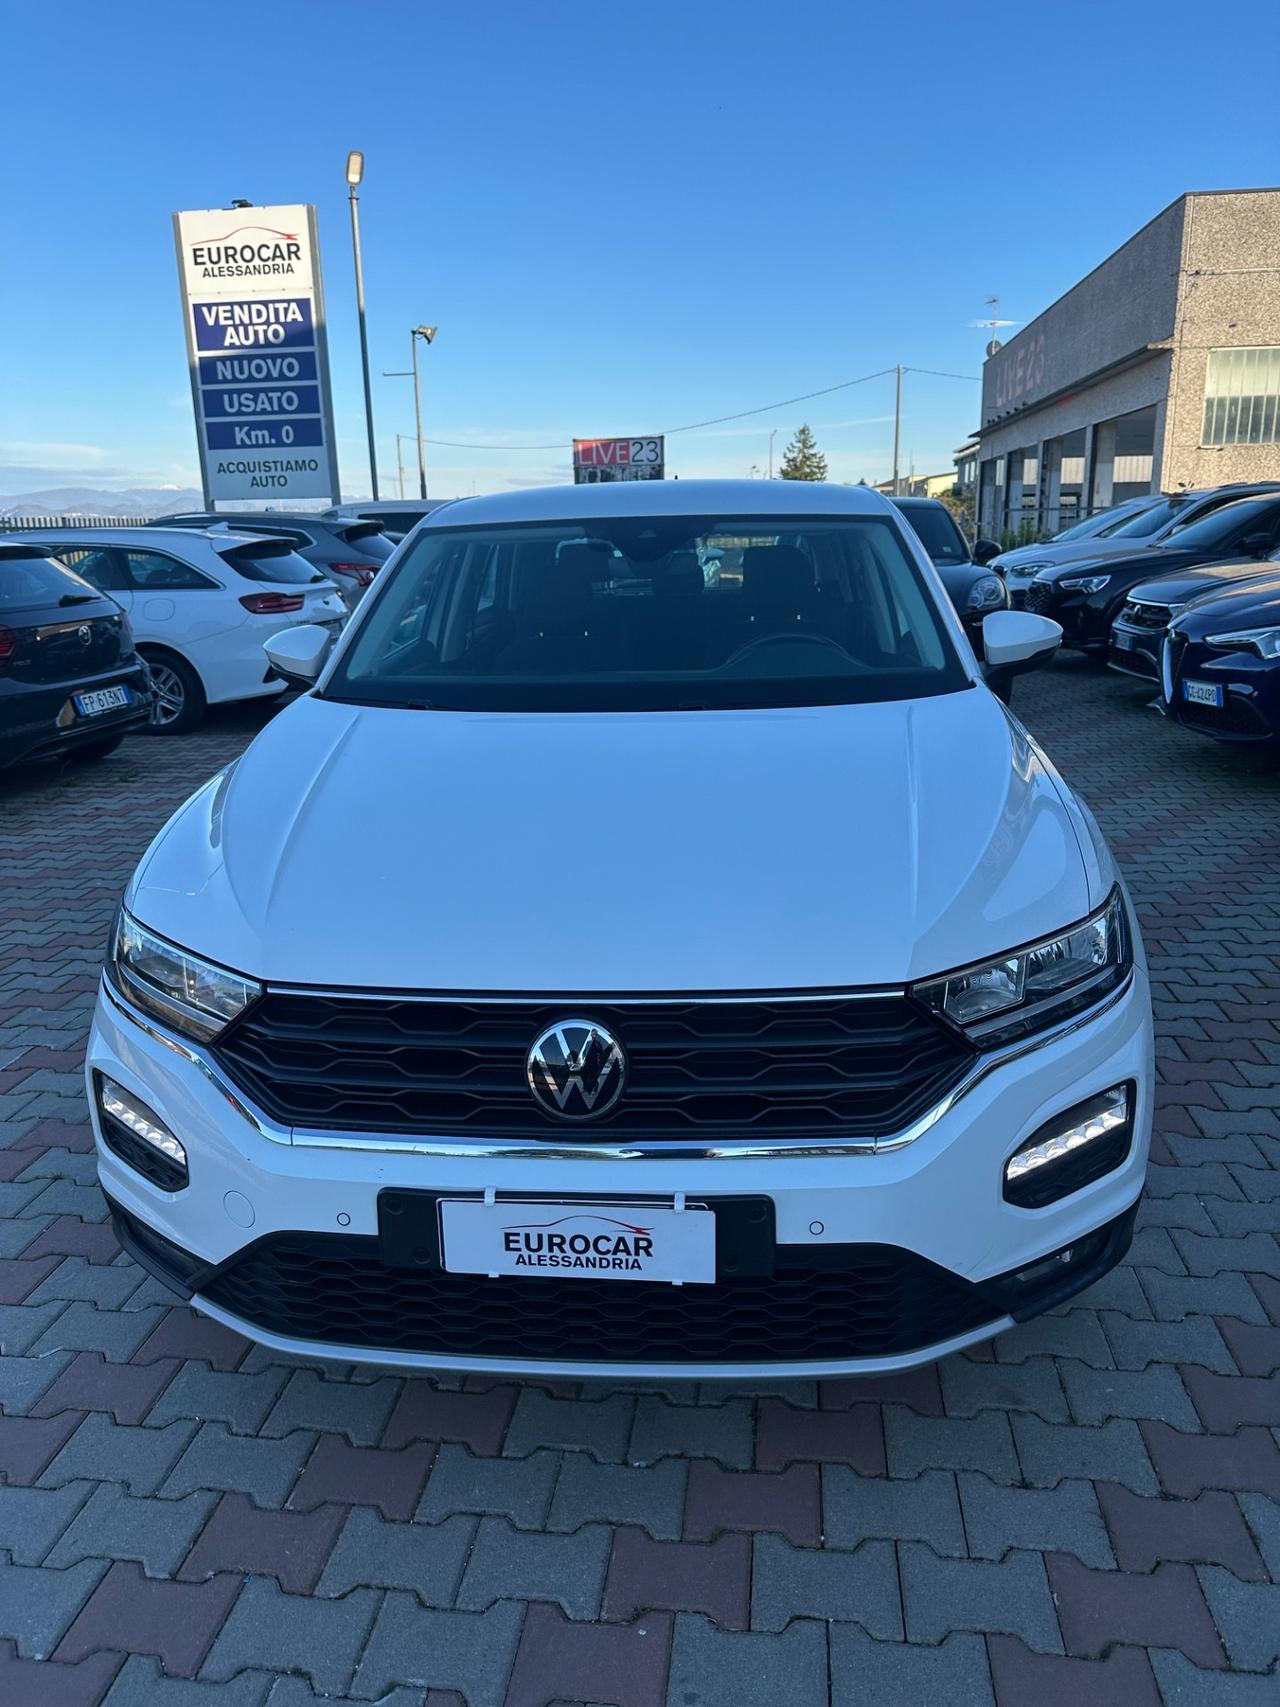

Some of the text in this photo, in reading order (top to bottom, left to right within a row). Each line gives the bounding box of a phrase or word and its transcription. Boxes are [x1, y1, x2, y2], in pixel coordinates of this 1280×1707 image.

[192, 243, 301, 266] EUROCAR
[202, 263, 295, 278] ALESSANDRIA
[201, 302, 303, 326] VENDITA
[224, 324, 285, 346] AUTO
[216, 357, 300, 380] NUOVO
[223, 391, 299, 413] USATO
[234, 425, 294, 445] Km. 0
[217, 459, 318, 474] ACQUISTIAMO
[250, 475, 288, 488] AUTO
[503, 1232, 654, 1257] EUROCAR
[515, 1255, 642, 1271] ALESSANDRIA
